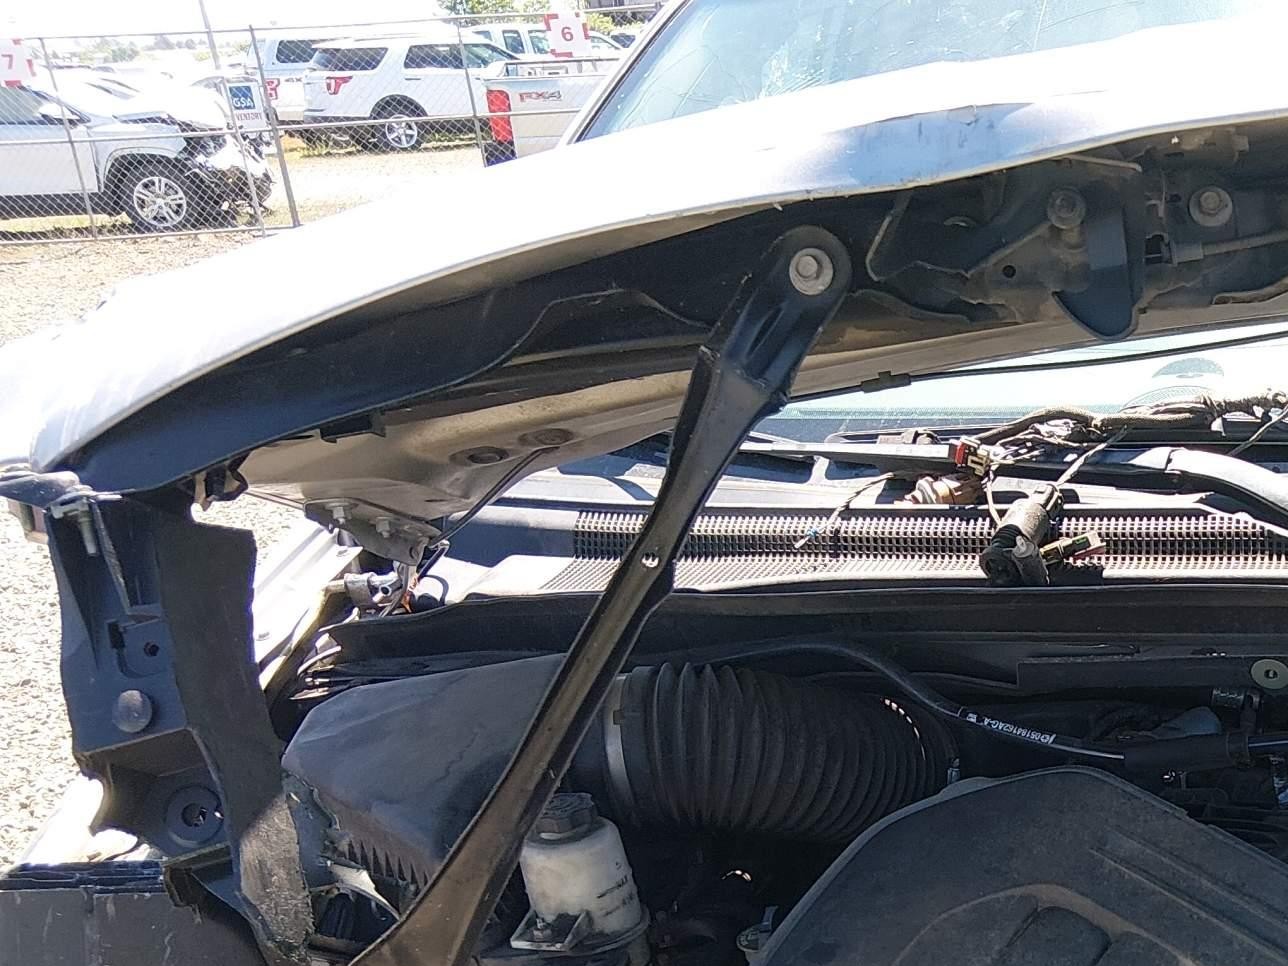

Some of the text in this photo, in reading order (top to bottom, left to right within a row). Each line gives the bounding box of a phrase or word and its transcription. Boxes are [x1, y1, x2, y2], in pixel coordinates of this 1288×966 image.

[560, 26, 574, 42] 6
[1, 53, 14, 70] 7
[232, 97, 256, 107] GSA
